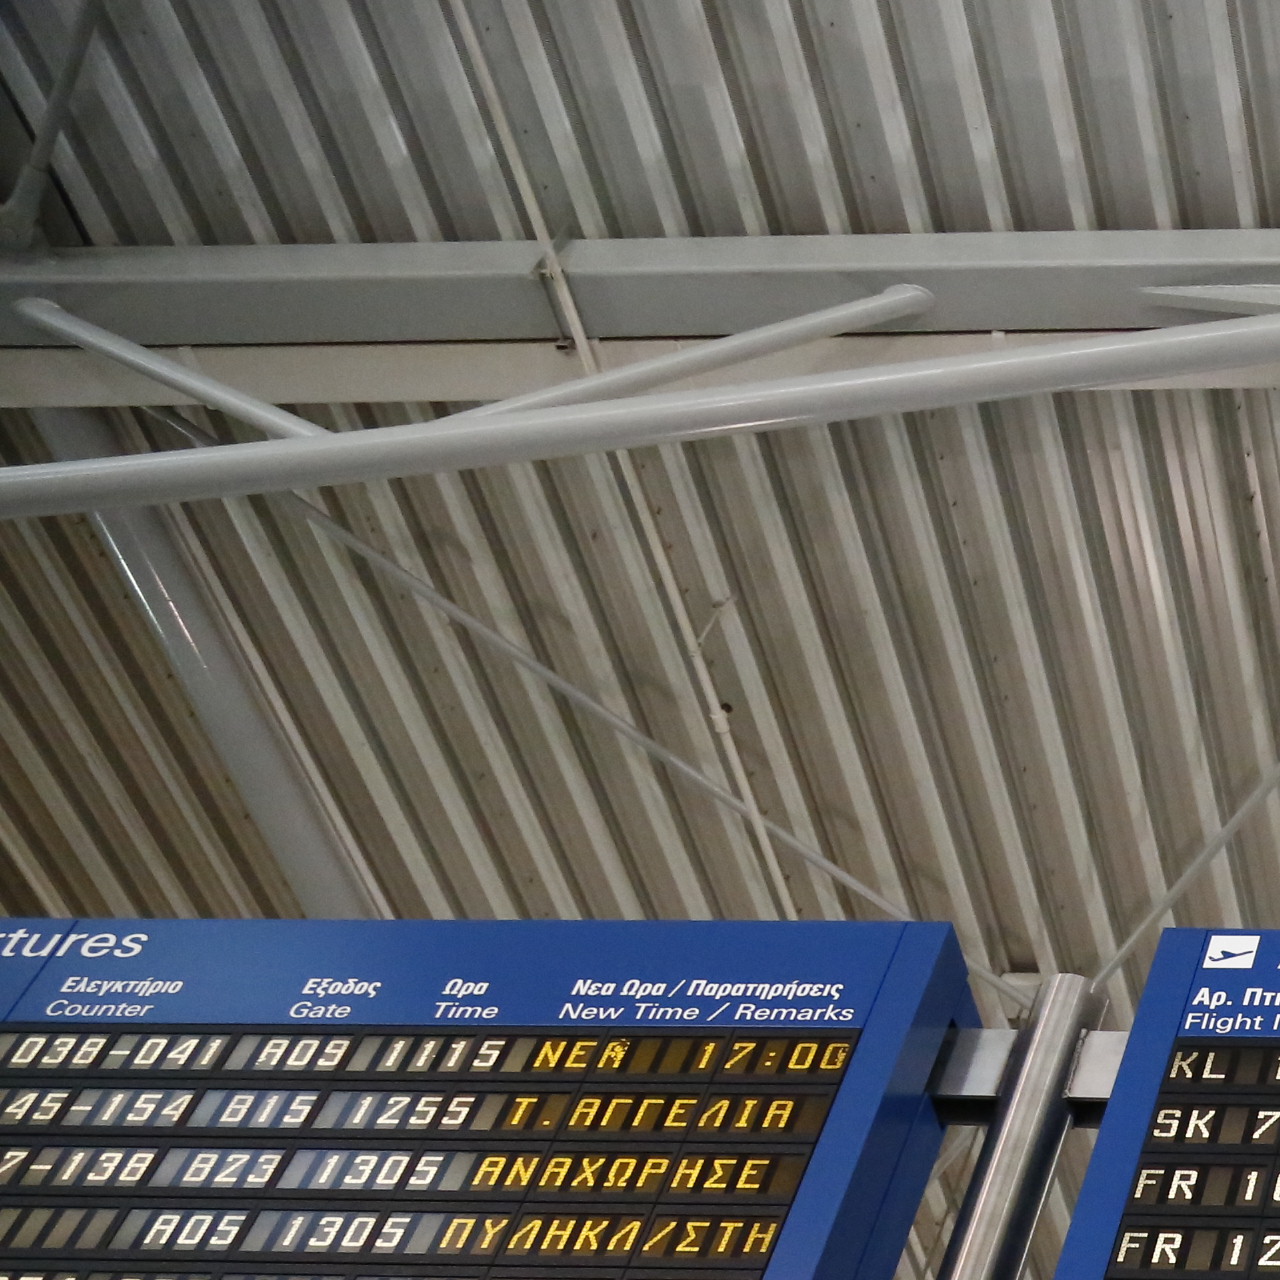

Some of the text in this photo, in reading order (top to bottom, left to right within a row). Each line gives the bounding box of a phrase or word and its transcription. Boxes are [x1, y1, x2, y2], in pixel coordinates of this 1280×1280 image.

[60, 977, 184, 997] Ελεγκτήριο
[302, 978, 382, 997] Εξοδος
[442, 979, 489, 998] Ωρα
[571, 980, 616, 996] Νεα
[620, 980, 665, 998] Ωρα
[686, 980, 844, 1000] Παρατηρήσεις
[46, 1000, 154, 1017] Counter
[1192, 988, 1232, 1009] Αρ.
[289, 1002, 352, 1018] Gate
[434, 1002, 498, 1019] Time
[558, 1003, 624, 1020] New
[634, 1003, 699, 1020] Time
[734, 1004, 854, 1021] Remarks
[1184, 1013, 1264, 1033] Flight
[11, 1037, 506, 1069] 038-041 A09 1115
[1170, 1053, 1225, 1078] KL
[220, 1095, 476, 1126] B15 1255
[1154, 1110, 1215, 1138] SK
[183, 1154, 770, 1191] B23 1305 ΑΝΑΧΩΡΗΣΕ
[1135, 1170, 1198, 1199] FR
[144, 1215, 246, 1245] A05
[282, 1217, 411, 1248] 1305
